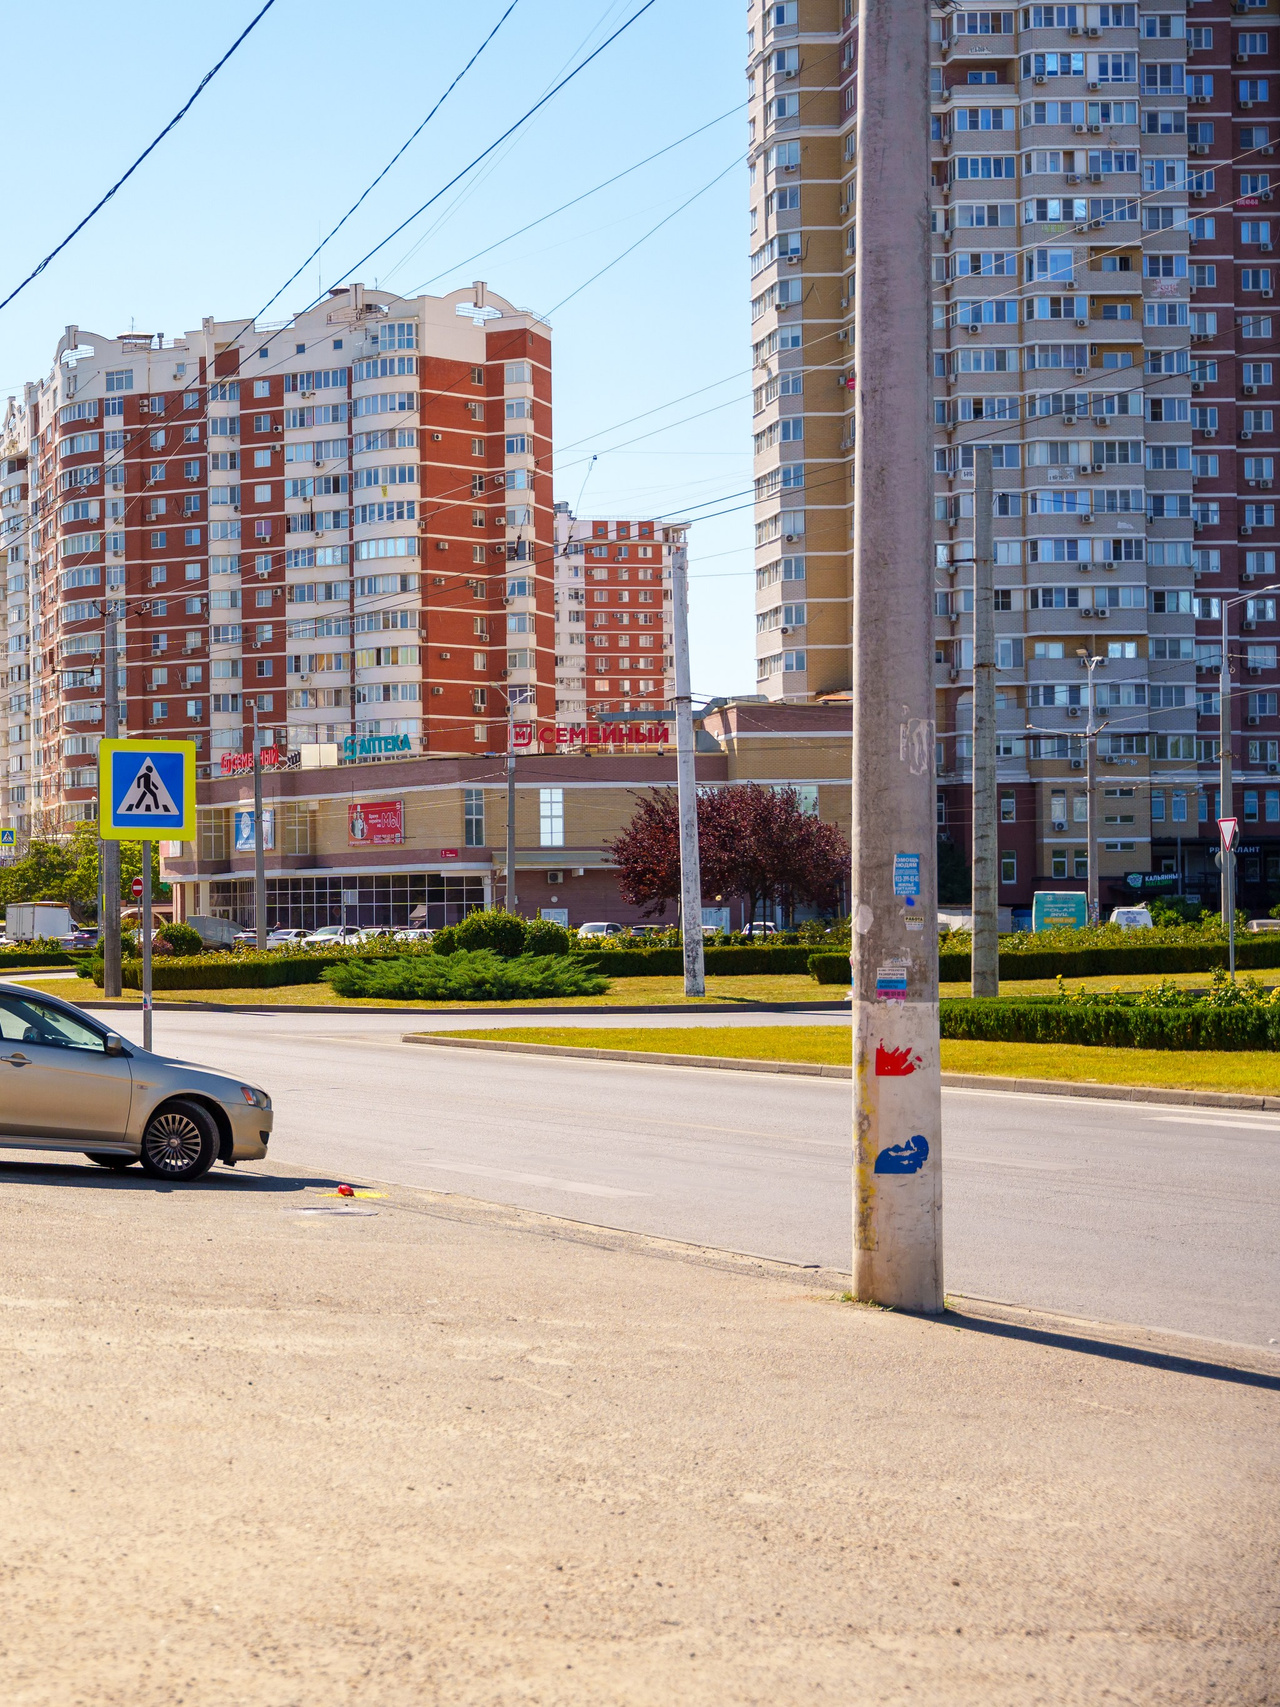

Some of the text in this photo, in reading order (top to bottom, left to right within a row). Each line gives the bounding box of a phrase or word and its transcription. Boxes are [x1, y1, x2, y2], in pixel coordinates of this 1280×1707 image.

[538, 722, 669, 744] СЕМЕЙНЫЙ
[358, 734, 412, 755] АПТЕКА
[232, 743, 279, 770] СЕМЕНЫЙ
[1145, 879, 1173, 887] МАГАЗИН
